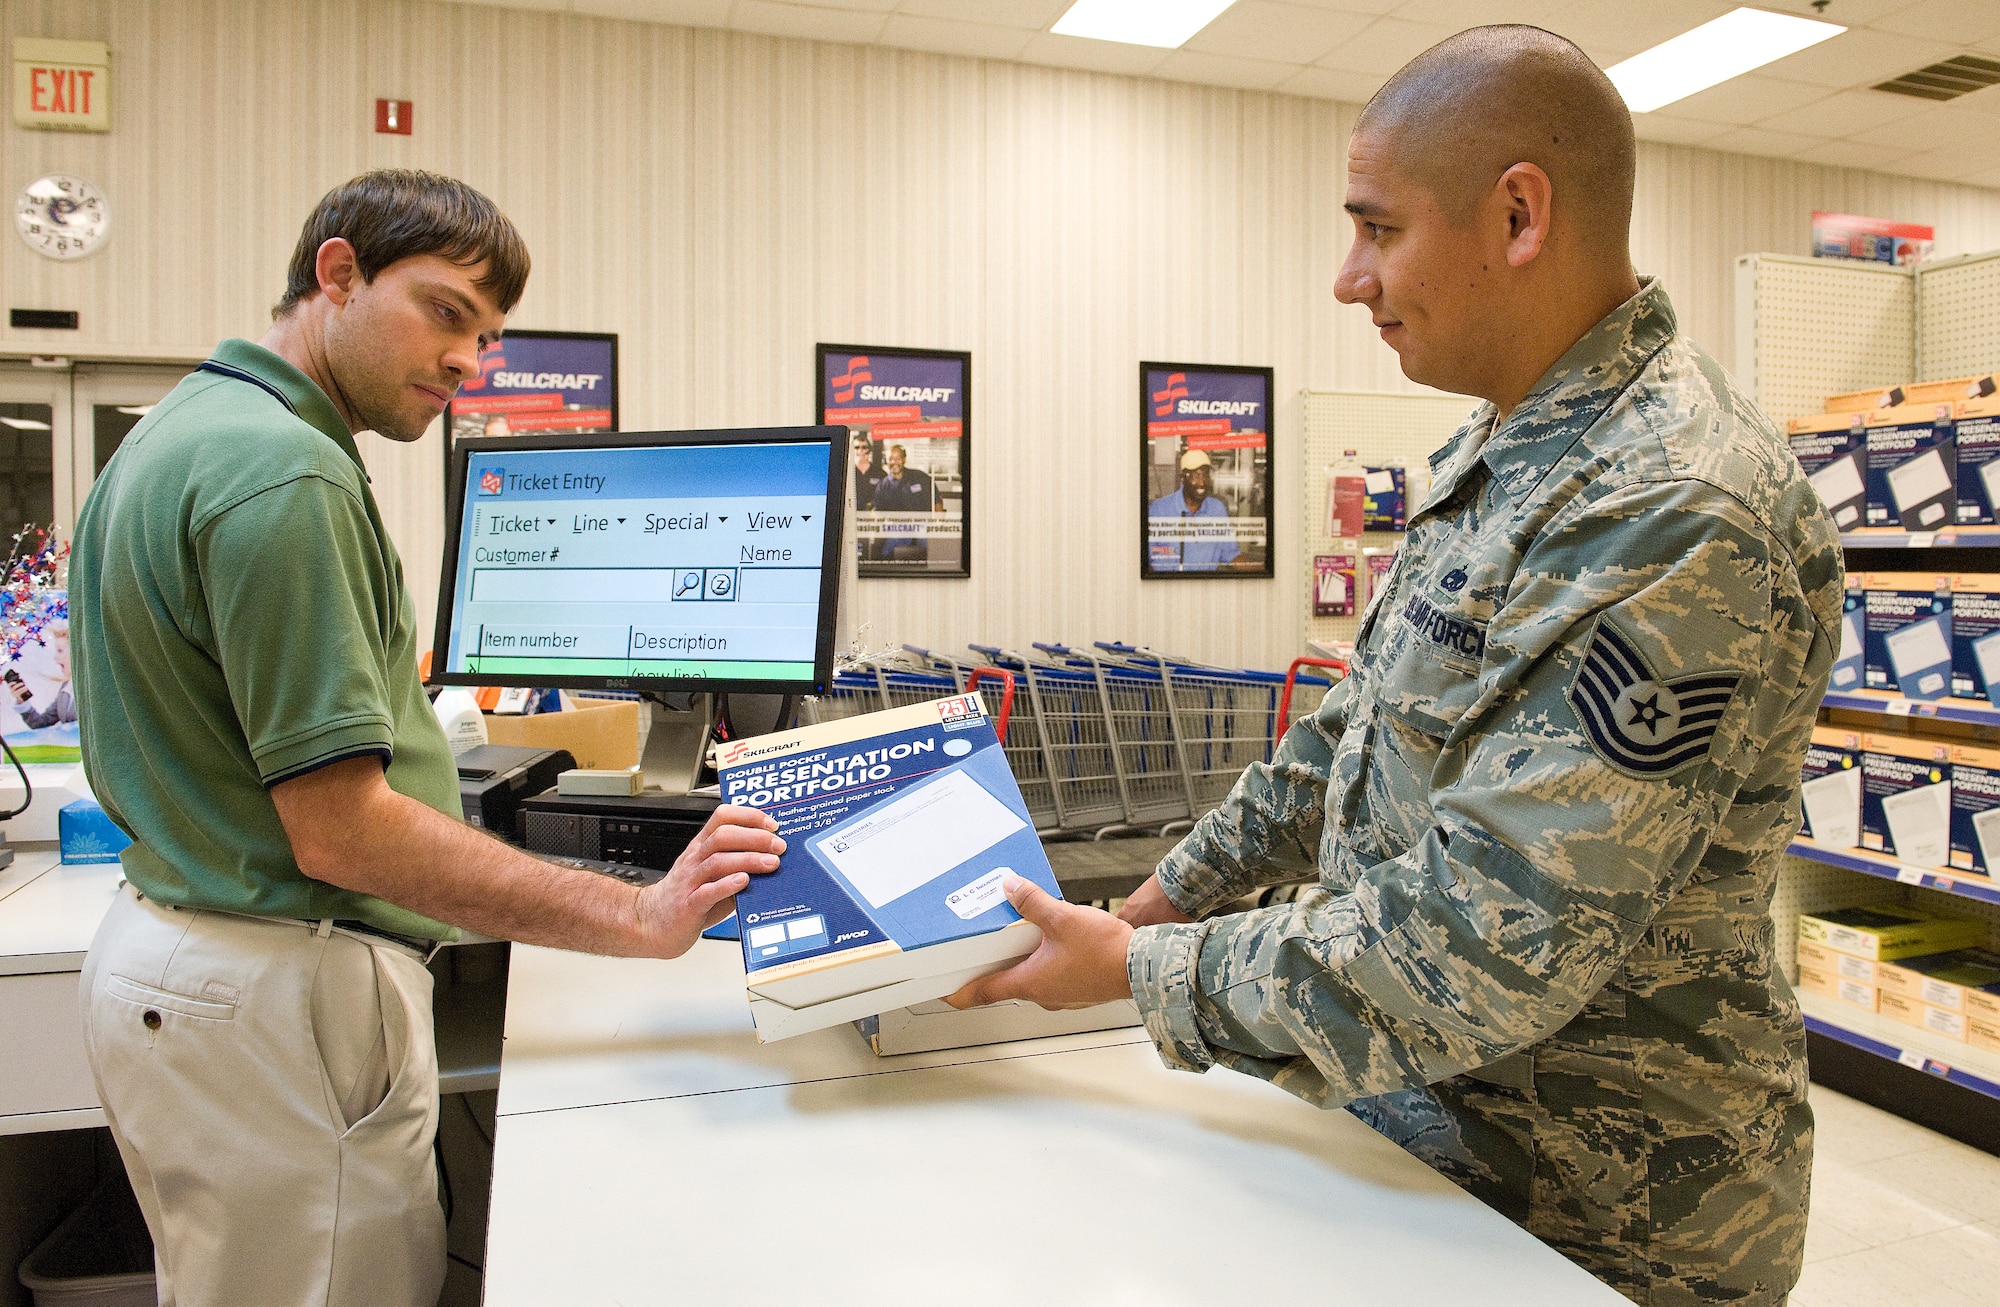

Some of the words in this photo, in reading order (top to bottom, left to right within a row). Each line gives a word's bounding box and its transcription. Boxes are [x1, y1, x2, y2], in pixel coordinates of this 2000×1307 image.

[30, 67, 95, 114] EXIT
[493, 371, 601, 391] SKILCRAFT
[860, 384, 954, 403] SKILCRAFT
[1177, 399, 1259, 416] SKILCRAFT
[1791, 435, 1848, 448] PRESENTATION
[1867, 429, 1933, 442] PRESENTATION
[1867, 439, 1917, 451] PORTFOLIO
[509, 474, 558, 491] Ticket
[563, 473, 606, 493] Entry
[490, 515, 540, 535] Ticket
[573, 514, 609, 534] Line
[644, 512, 708, 534] Special
[746, 512, 793, 532] View
[475, 547, 547, 564] Customer
[550, 547, 560, 562] #
[740, 545, 792, 563] Name
[1866, 597, 1933, 607] PRESENTATION
[1866, 605, 1916, 616] PORTFOLIO
[484, 631, 516, 647] Item
[520, 631, 579, 648] number
[634, 632, 728, 653] Description
[938, 700, 965, 718] 25
[743, 741, 802, 759] SKILCRAFT
[1807, 749, 1843, 761] NTATION
[726, 763, 775, 781] DOUBLE
[779, 753, 828, 768] POCKET
[728, 738, 935, 796] PRESENTATION
[1804, 758, 1829, 768] FOLIO
[1865, 758, 1930, 775] PRESENTATION
[1865, 767, 1914, 782] PORTFOLIO
[731, 764, 892, 807] PORTFOLIO
[778, 797, 844, 819] leather-grained
[846, 792, 872, 803] paper
[874, 785, 896, 796] stock
[777, 811, 817, 826] tter-sized
[819, 805, 849, 820] papers
[778, 823, 812, 836] expand
[814, 817, 837, 829] 3/8"
[834, 929, 870, 944] JWOD
